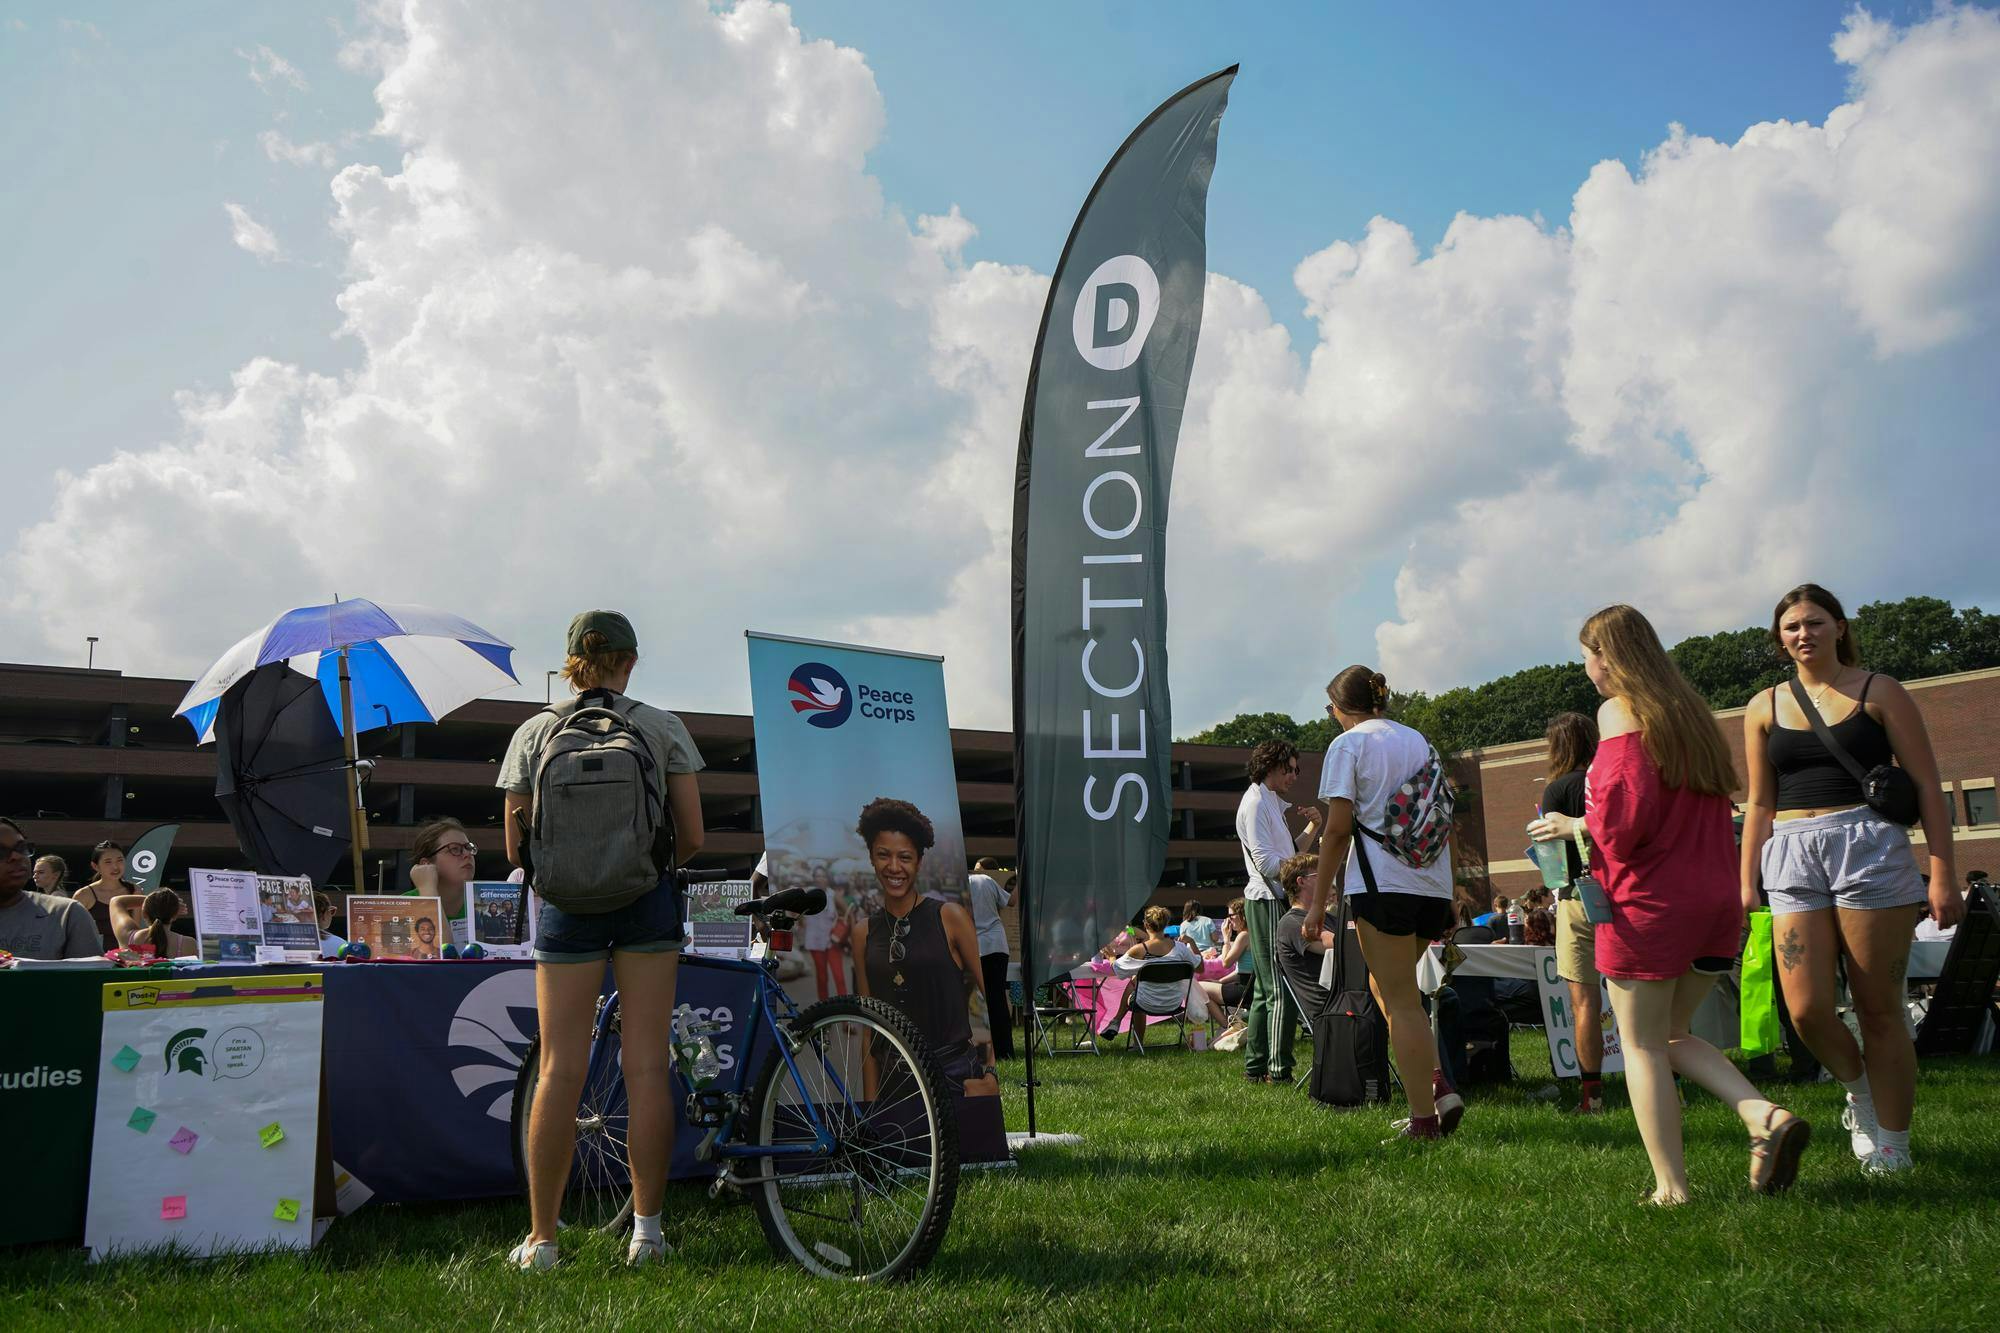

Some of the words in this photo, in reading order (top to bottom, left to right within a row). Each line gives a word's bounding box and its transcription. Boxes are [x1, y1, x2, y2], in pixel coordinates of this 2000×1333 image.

[1092, 282, 1140, 350] D
[1081, 396, 1149, 824] SECTION
[858, 684, 914, 705] Peace
[860, 702, 916, 723] Corps
[137, 855, 152, 869] C
[480, 891, 522, 899] difference?
[691, 884, 719, 896] PEACE
[721, 884, 750, 896] CORPS
[130, 991, 155, 1000] Post-it
